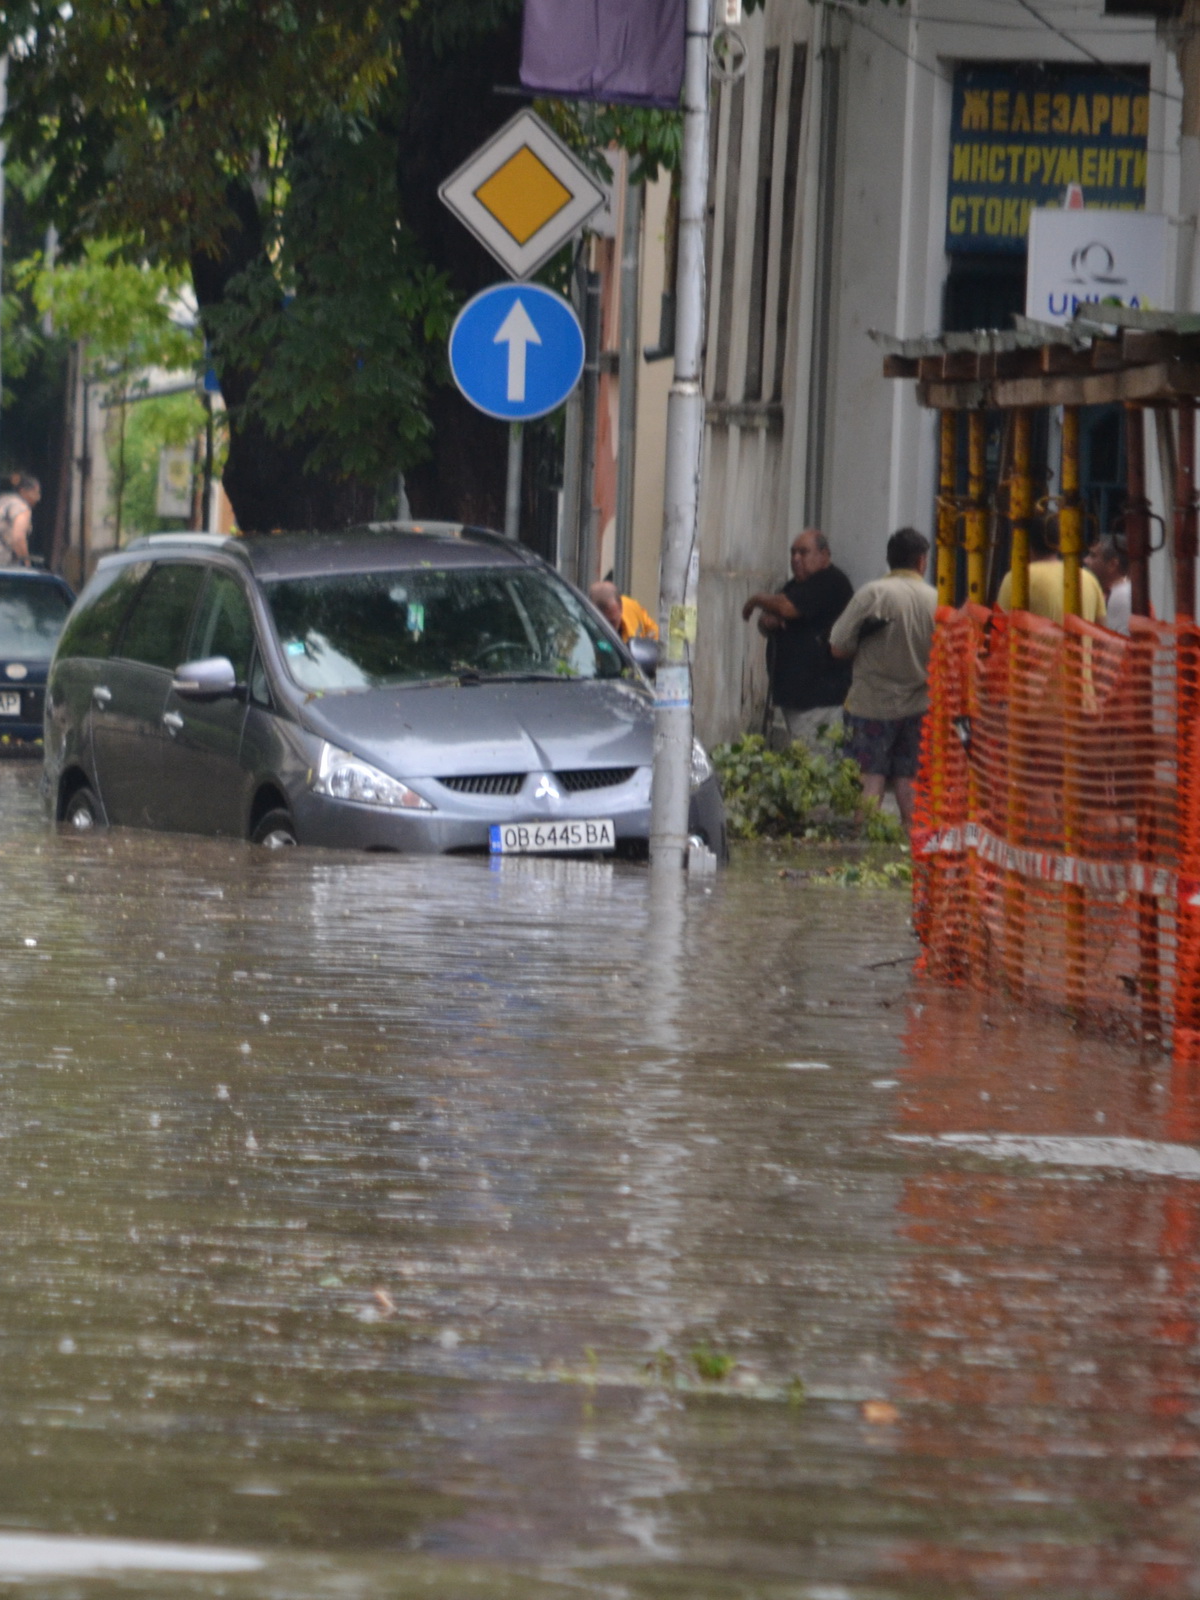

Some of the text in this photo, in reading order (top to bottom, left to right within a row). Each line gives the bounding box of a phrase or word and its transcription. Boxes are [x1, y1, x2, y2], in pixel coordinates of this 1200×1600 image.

[961, 90, 1149, 136] ЖЕЛЕЗАРИЯ
[952, 144, 1148, 188] ИНСТРУМЕНТИ
[504, 822, 611, 848] OB 6445 BA
